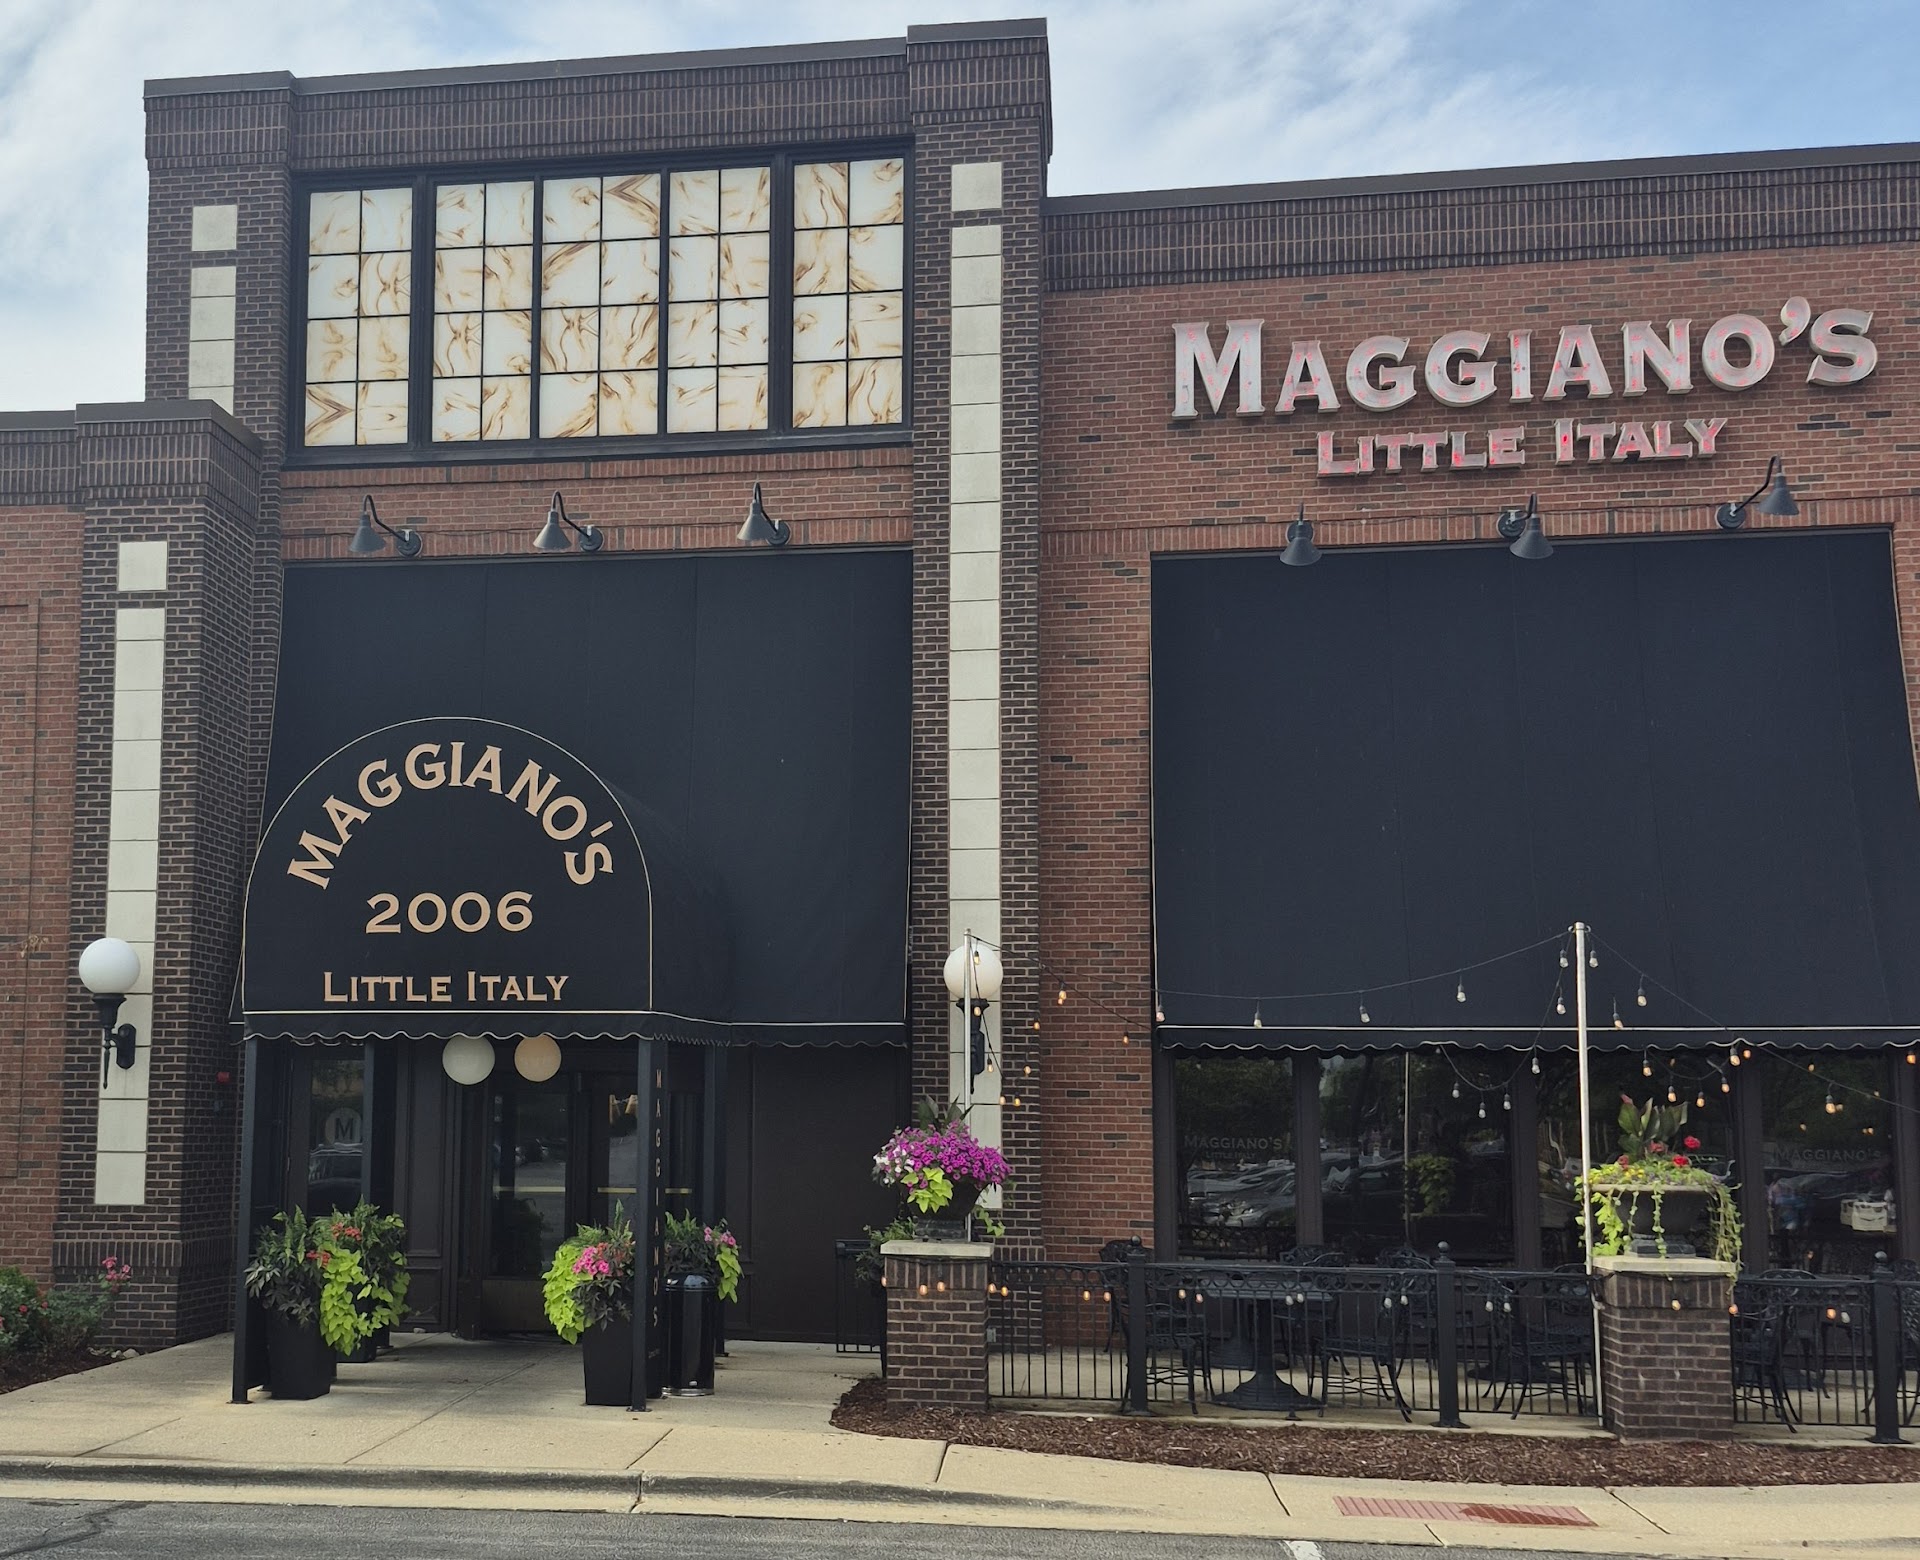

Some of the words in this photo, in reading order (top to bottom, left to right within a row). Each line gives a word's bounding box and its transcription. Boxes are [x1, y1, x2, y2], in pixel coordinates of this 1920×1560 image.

[1172, 296, 1878, 420] MAGGIANO'S
[1316, 428, 1525, 478] LITTLE
[1554, 417, 1729, 465] ITALY
[287, 741, 614, 890] MAGGIANO'S
[366, 891, 533, 934] 2006
[323, 971, 452, 1003] LITTLE
[467, 970, 569, 1002] ITALY
[334, 1117, 355, 1141] M
[1184, 1135, 1283, 1150] MAGGIANO'S
